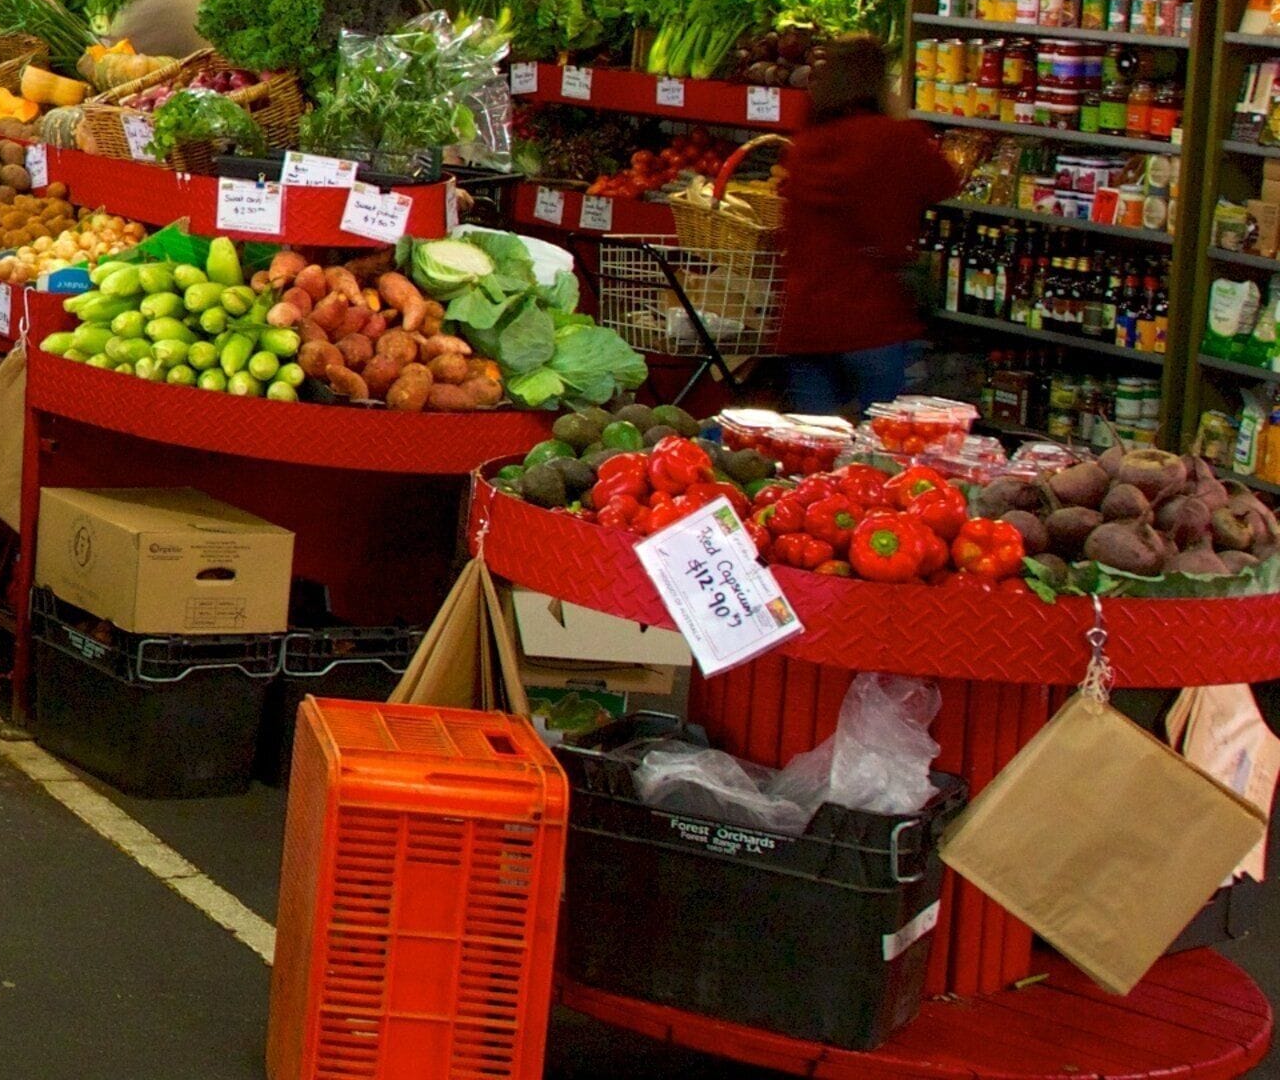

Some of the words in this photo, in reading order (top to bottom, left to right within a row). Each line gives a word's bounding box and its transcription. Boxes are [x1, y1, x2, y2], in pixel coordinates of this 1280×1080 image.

[697, 526, 722, 557] Red
[716, 560, 755, 618] Capsicum
[670, 819, 710, 836] Forest
[716, 828, 776, 850] Orchards
